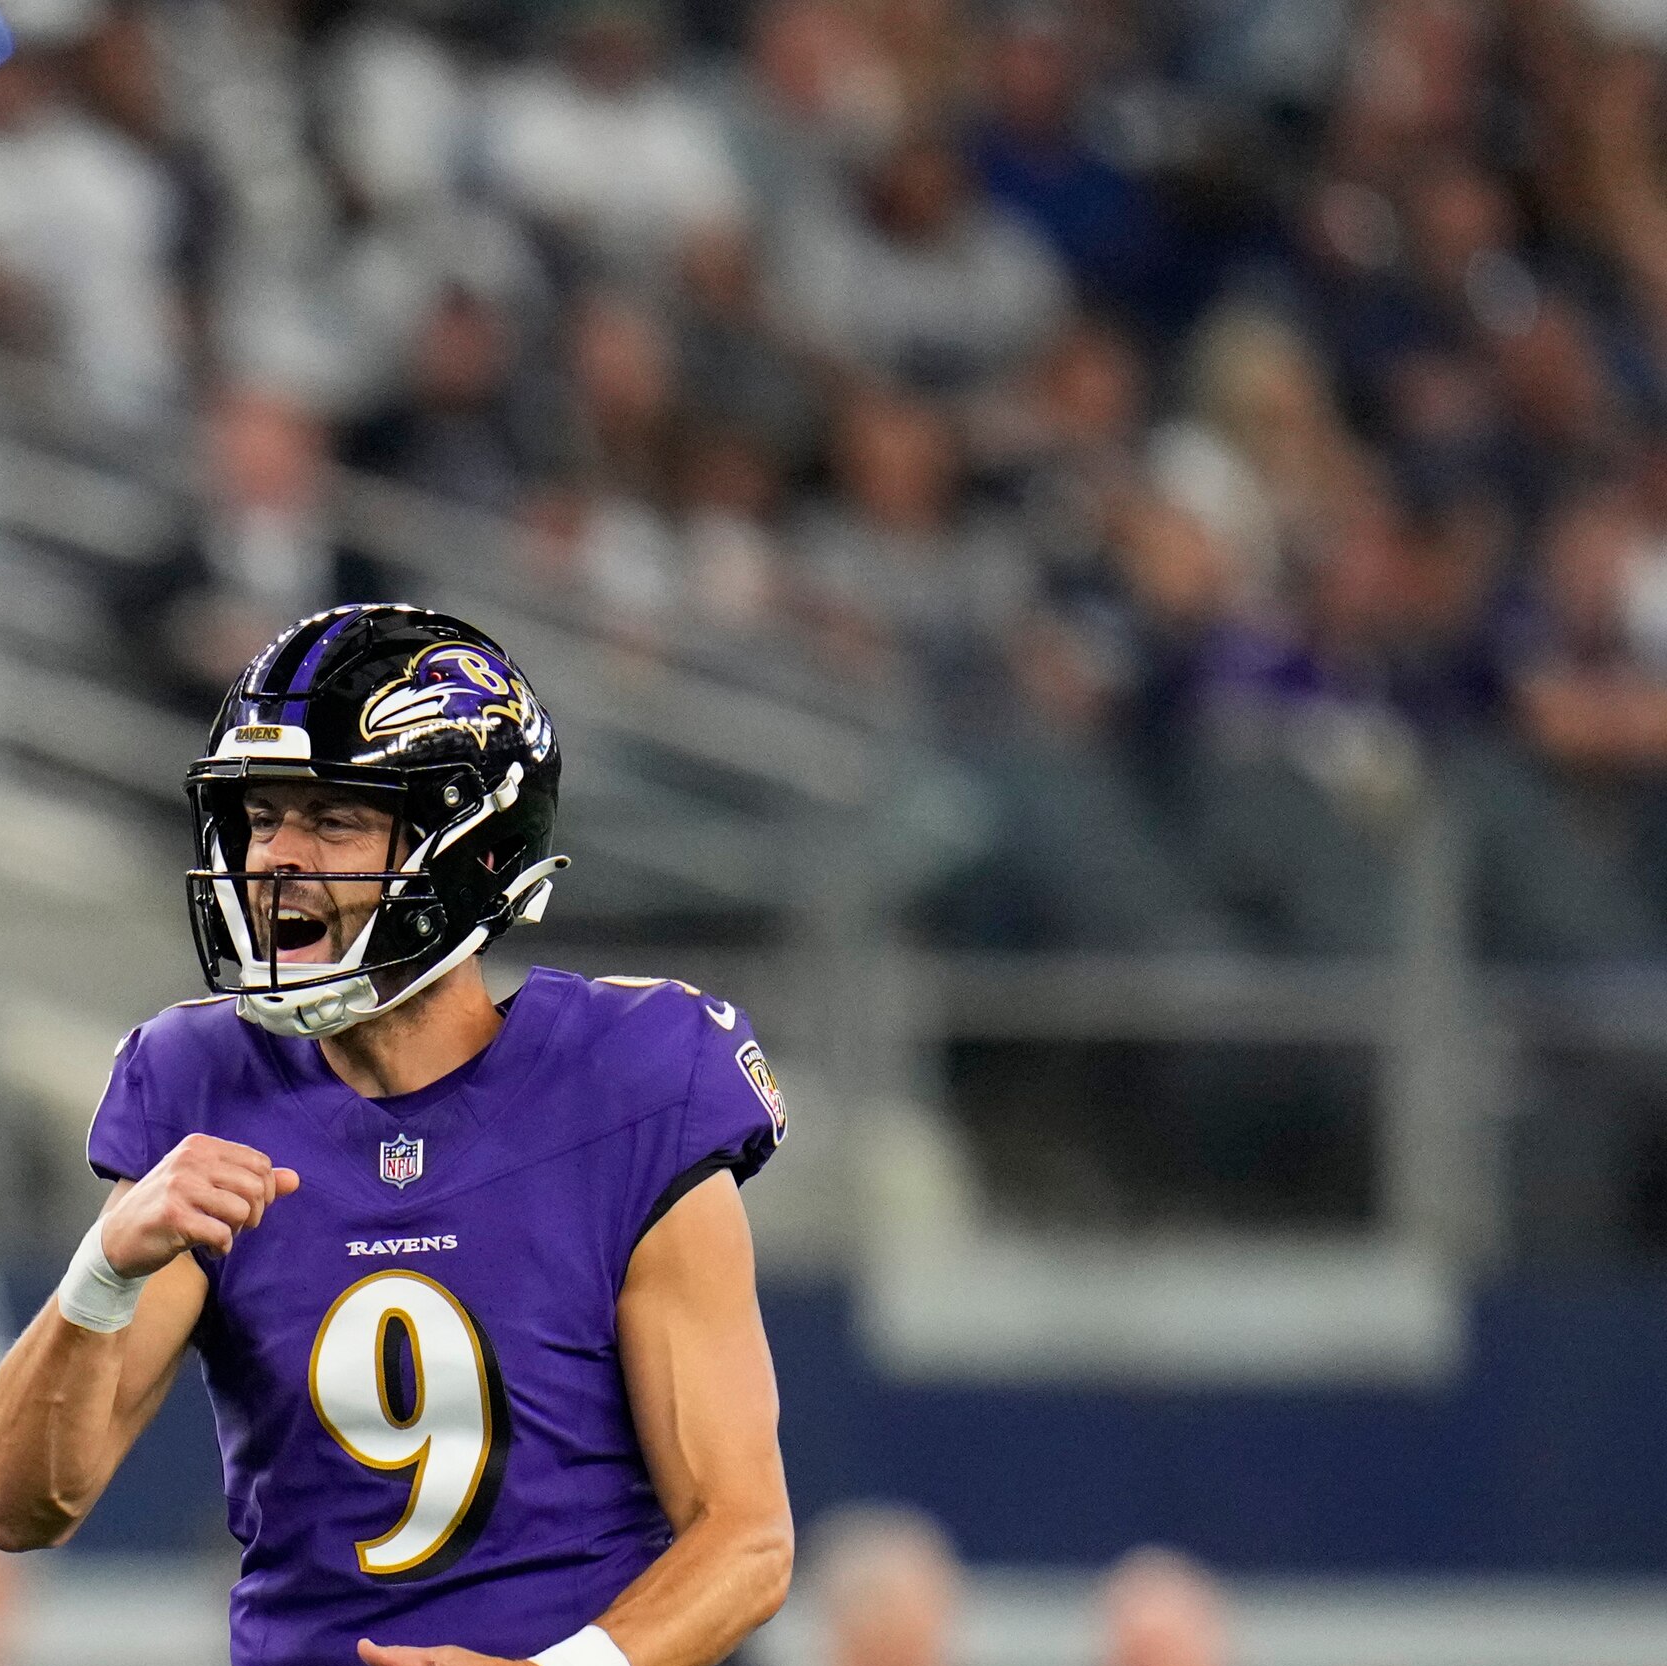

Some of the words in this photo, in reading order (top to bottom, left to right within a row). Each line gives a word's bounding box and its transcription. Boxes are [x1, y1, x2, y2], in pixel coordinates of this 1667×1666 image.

[387, 1157, 416, 1178] NFL
[345, 1235, 458, 1256] RAVENS
[308, 1269, 493, 1575] 9
